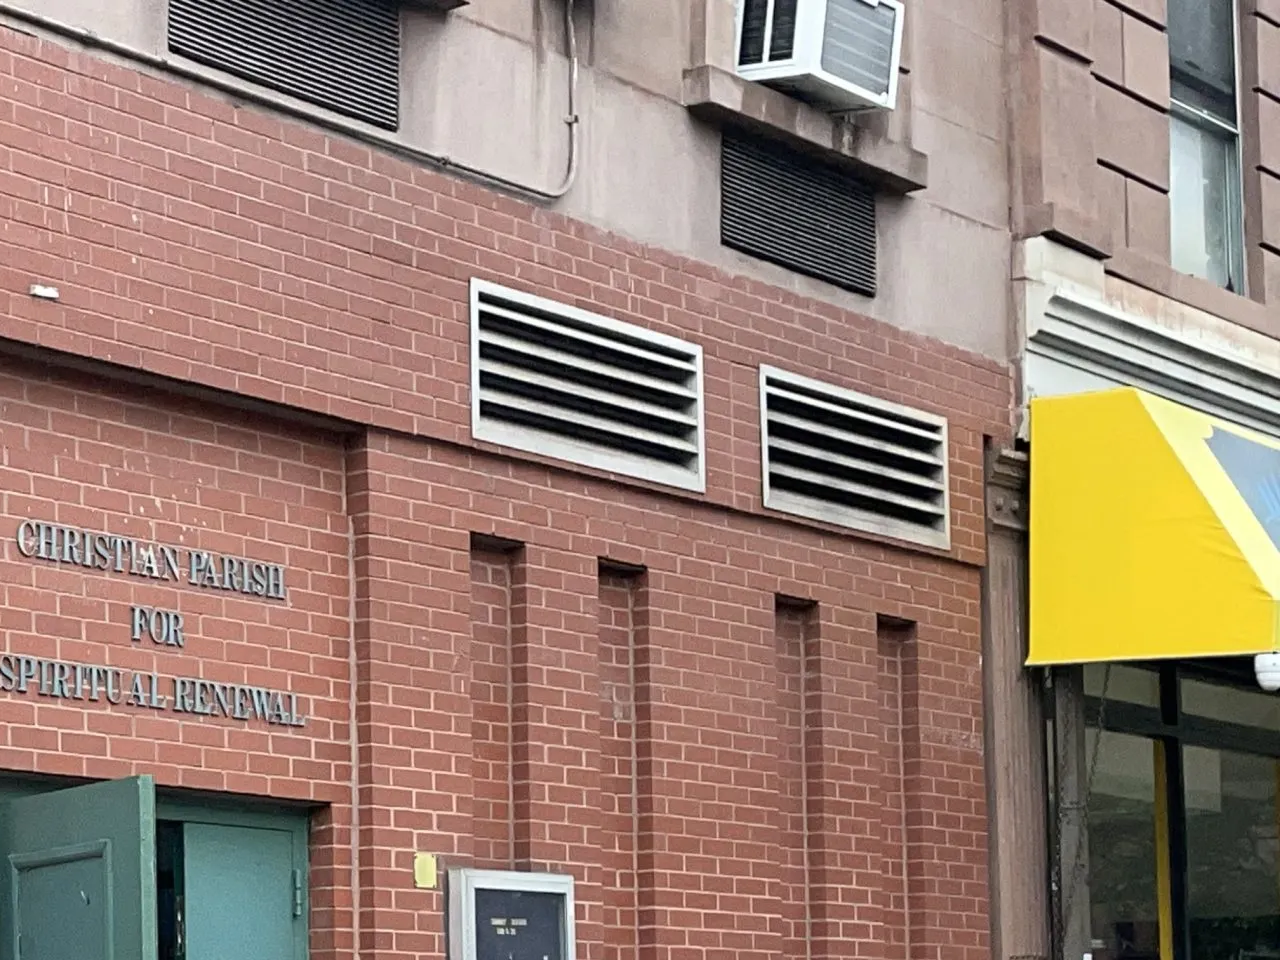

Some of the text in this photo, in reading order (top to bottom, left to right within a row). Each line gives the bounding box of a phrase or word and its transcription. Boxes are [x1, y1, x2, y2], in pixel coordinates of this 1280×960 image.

[17, 519, 287, 600] CHRISTIAN PARISH
[131, 606, 184, 648] FOR
[173, 677, 307, 727] RENEWAL
